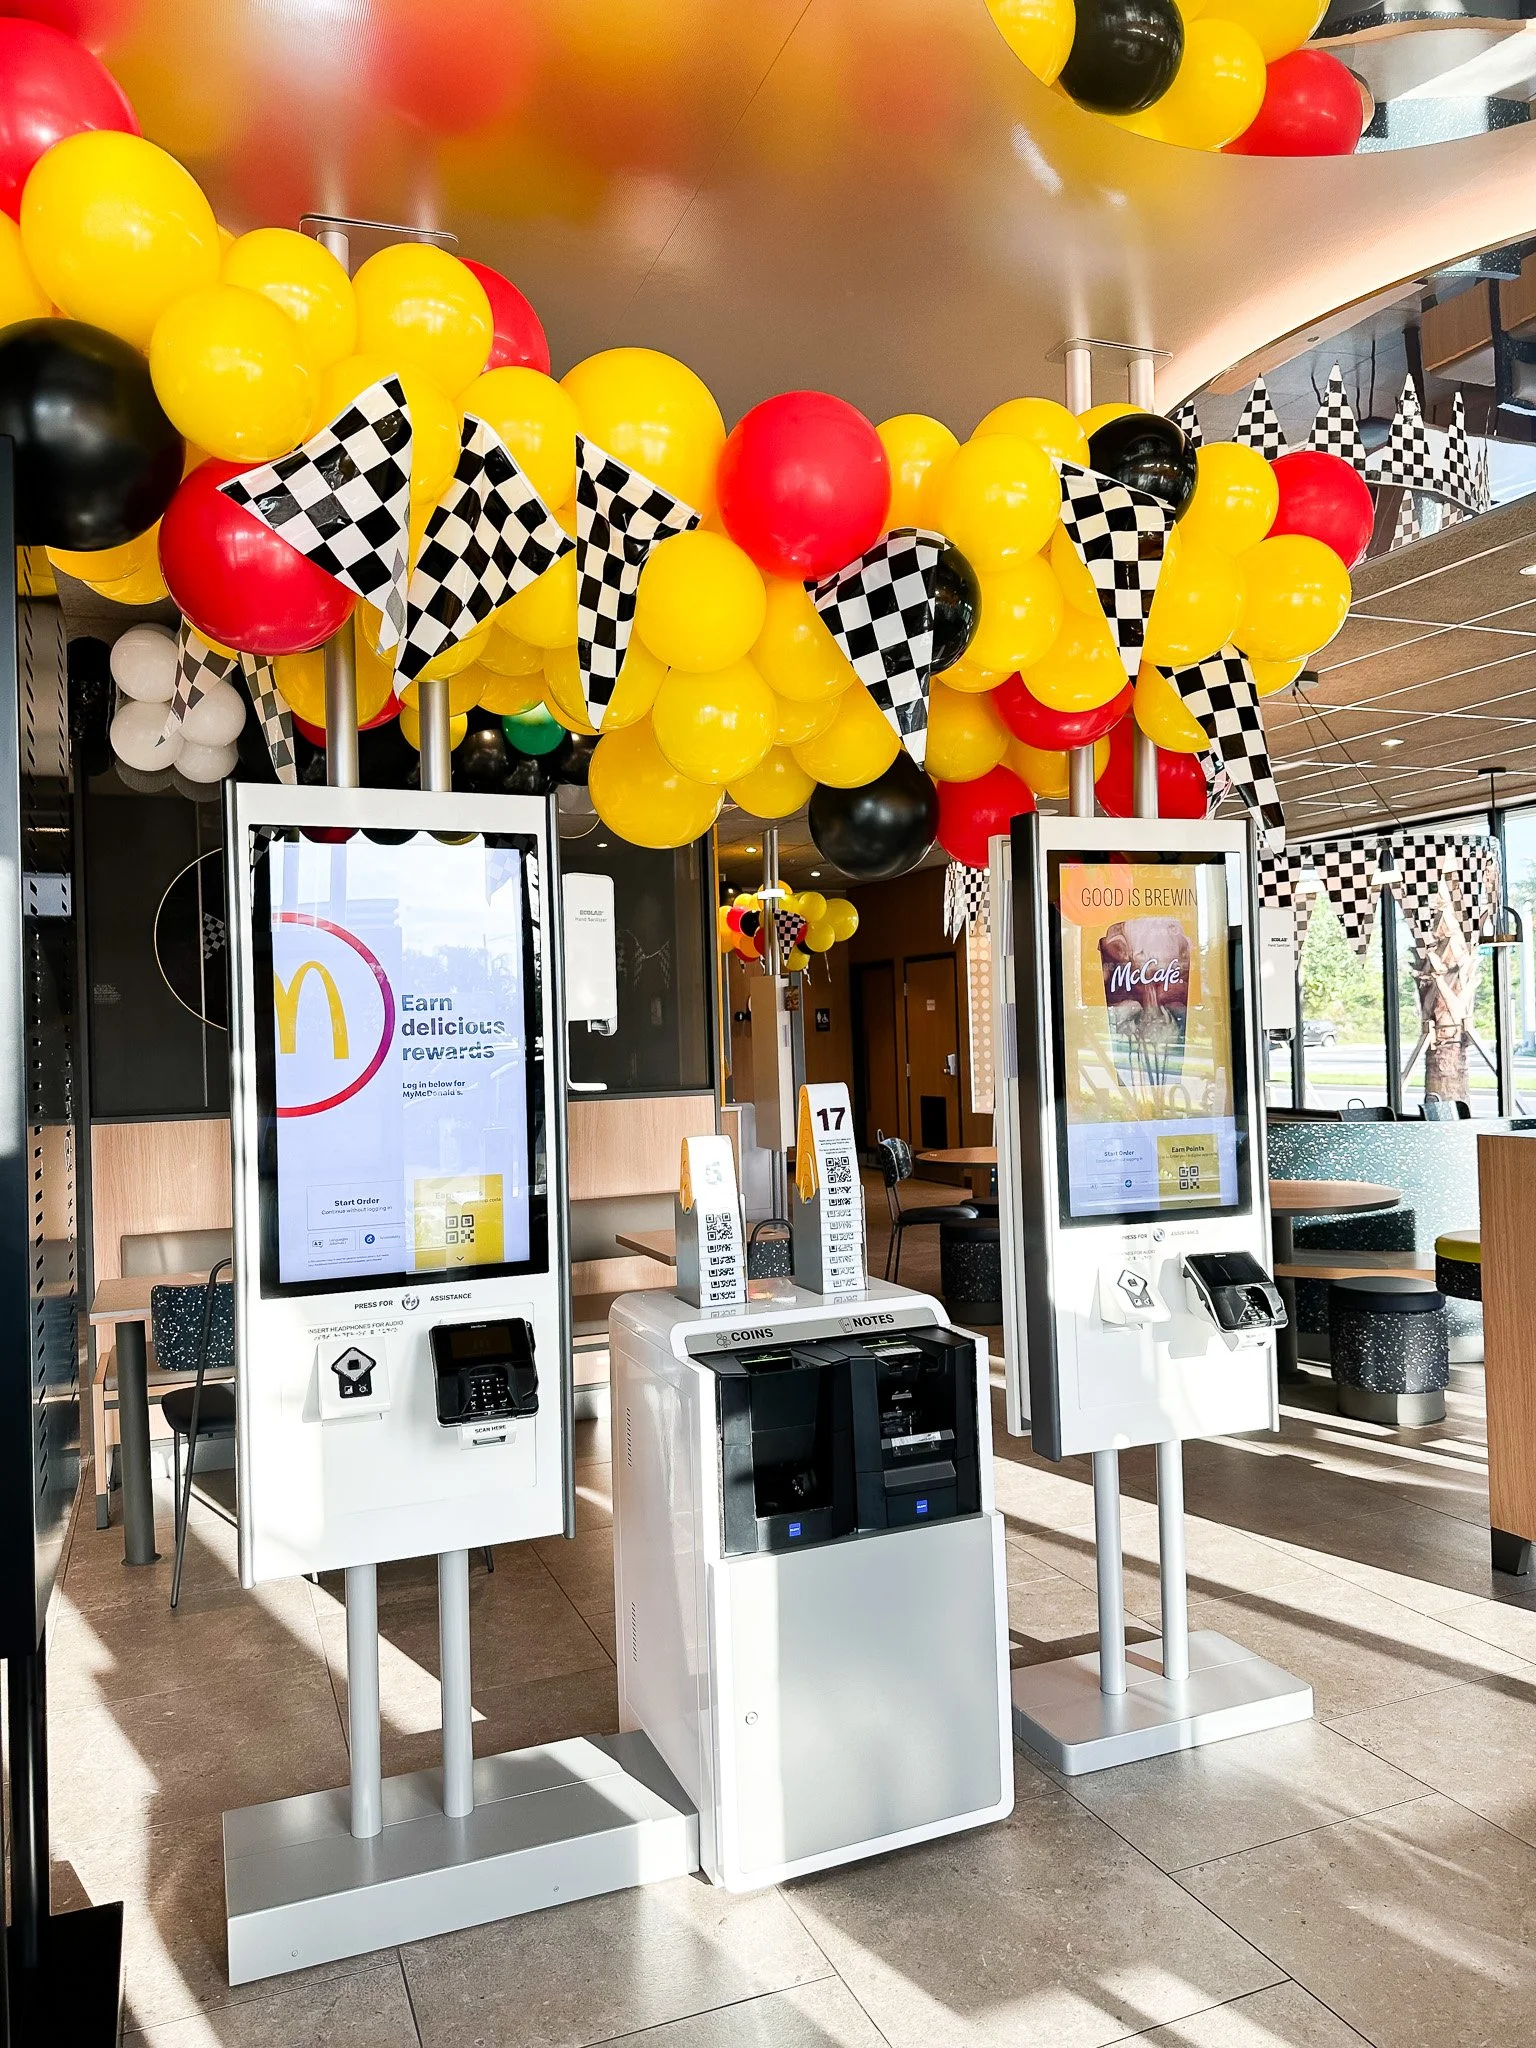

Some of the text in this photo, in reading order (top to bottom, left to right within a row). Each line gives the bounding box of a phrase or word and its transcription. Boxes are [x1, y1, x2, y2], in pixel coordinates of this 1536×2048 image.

[1081, 887, 1124, 907] GOOD
[1128, 887, 1141, 907] IS
[401, 994, 453, 1012] Earn
[401, 1016, 505, 1037] delicious
[402, 1041, 495, 1061] rewards
[402, 1081, 417, 1090] Log
[428, 1080, 453, 1088] below
[454, 1079, 466, 1087] for
[816, 1107, 846, 1131] 17
[334, 1197, 380, 1207] Start Order
[354, 1301, 378, 1310] PRESS
[430, 1292, 472, 1302] ASSISTANCE
[330, 1323, 371, 1332] HEADPHONES
[852, 1313, 895, 1327] NOTES
[731, 1328, 774, 1342] COINS
[474, 1426, 491, 1434] SCAN
